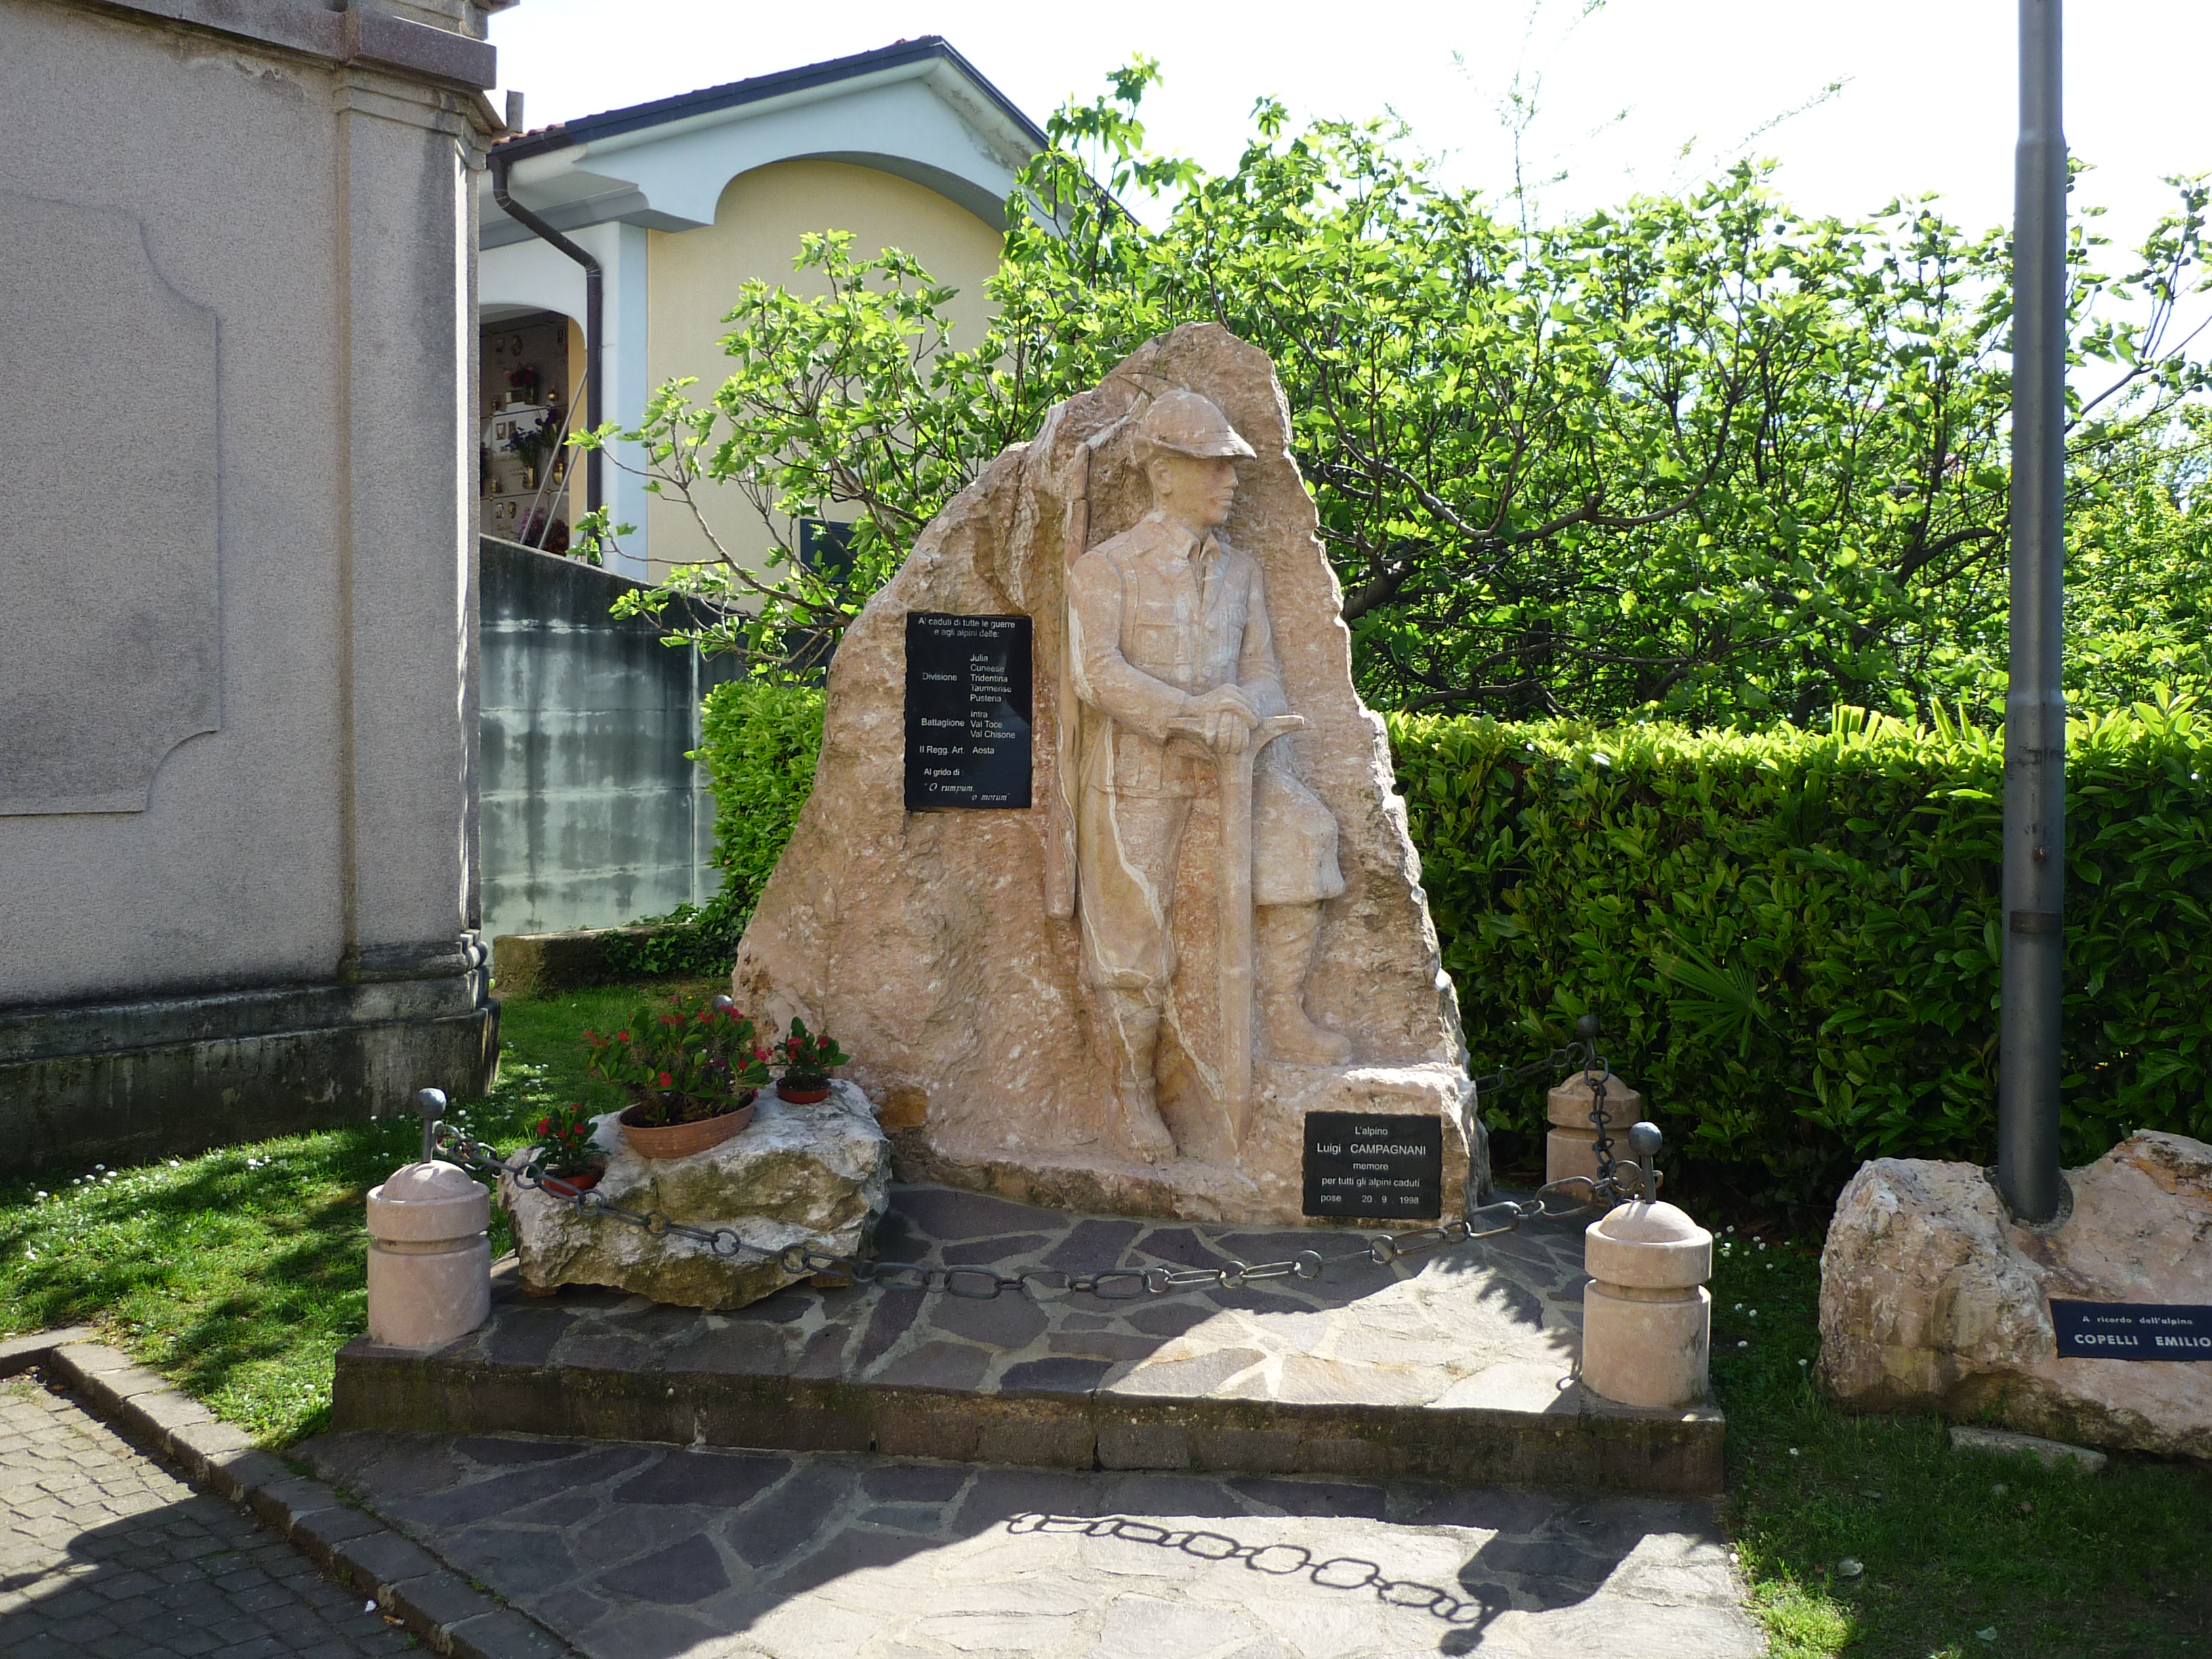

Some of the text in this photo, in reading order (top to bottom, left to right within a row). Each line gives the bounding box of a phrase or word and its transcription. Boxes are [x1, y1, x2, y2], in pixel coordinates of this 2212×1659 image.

[928, 617, 952, 626] caduti
[954, 618, 961, 626] di
[963, 619, 980, 628] tutte
[982, 619, 989, 628] le
[990, 621, 1016, 630] guerre
[941, 628, 955, 637] agli
[957, 629, 977, 638] alpini
[970, 653, 989, 662] Julia
[970, 663, 1005, 673] Cuneese
[922, 672, 958, 682] Divisione
[970, 674, 1008, 682] Tridentina
[970, 684, 1012, 693] Taurinense
[970, 693, 1002, 703] Pusteria
[970, 710, 988, 718] Intra
[921, 718, 965, 728] Battaglione
[970, 720, 1003, 729] Val Toce
[970, 730, 1016, 739] Val Chisone
[972, 746, 995, 755] Aosta
[924, 768, 932, 776] Al
[933, 768, 951, 777] grido
[1355, 1126, 1388, 1136] L'alpino
[1317, 1143, 1426, 1155] Luigi CAMPAGNANI
[1353, 1162, 1389, 1171] memore
[1322, 1176, 1420, 1188] per tutti gli alpini caduti
[1320, 1194, 1342, 1204] pose
[1399, 1196, 1419, 1204] 1998
[2139, 1316, 2194, 1326] dell'alpino
[2074, 1334, 2211, 1347] COPELLI EMILIO
